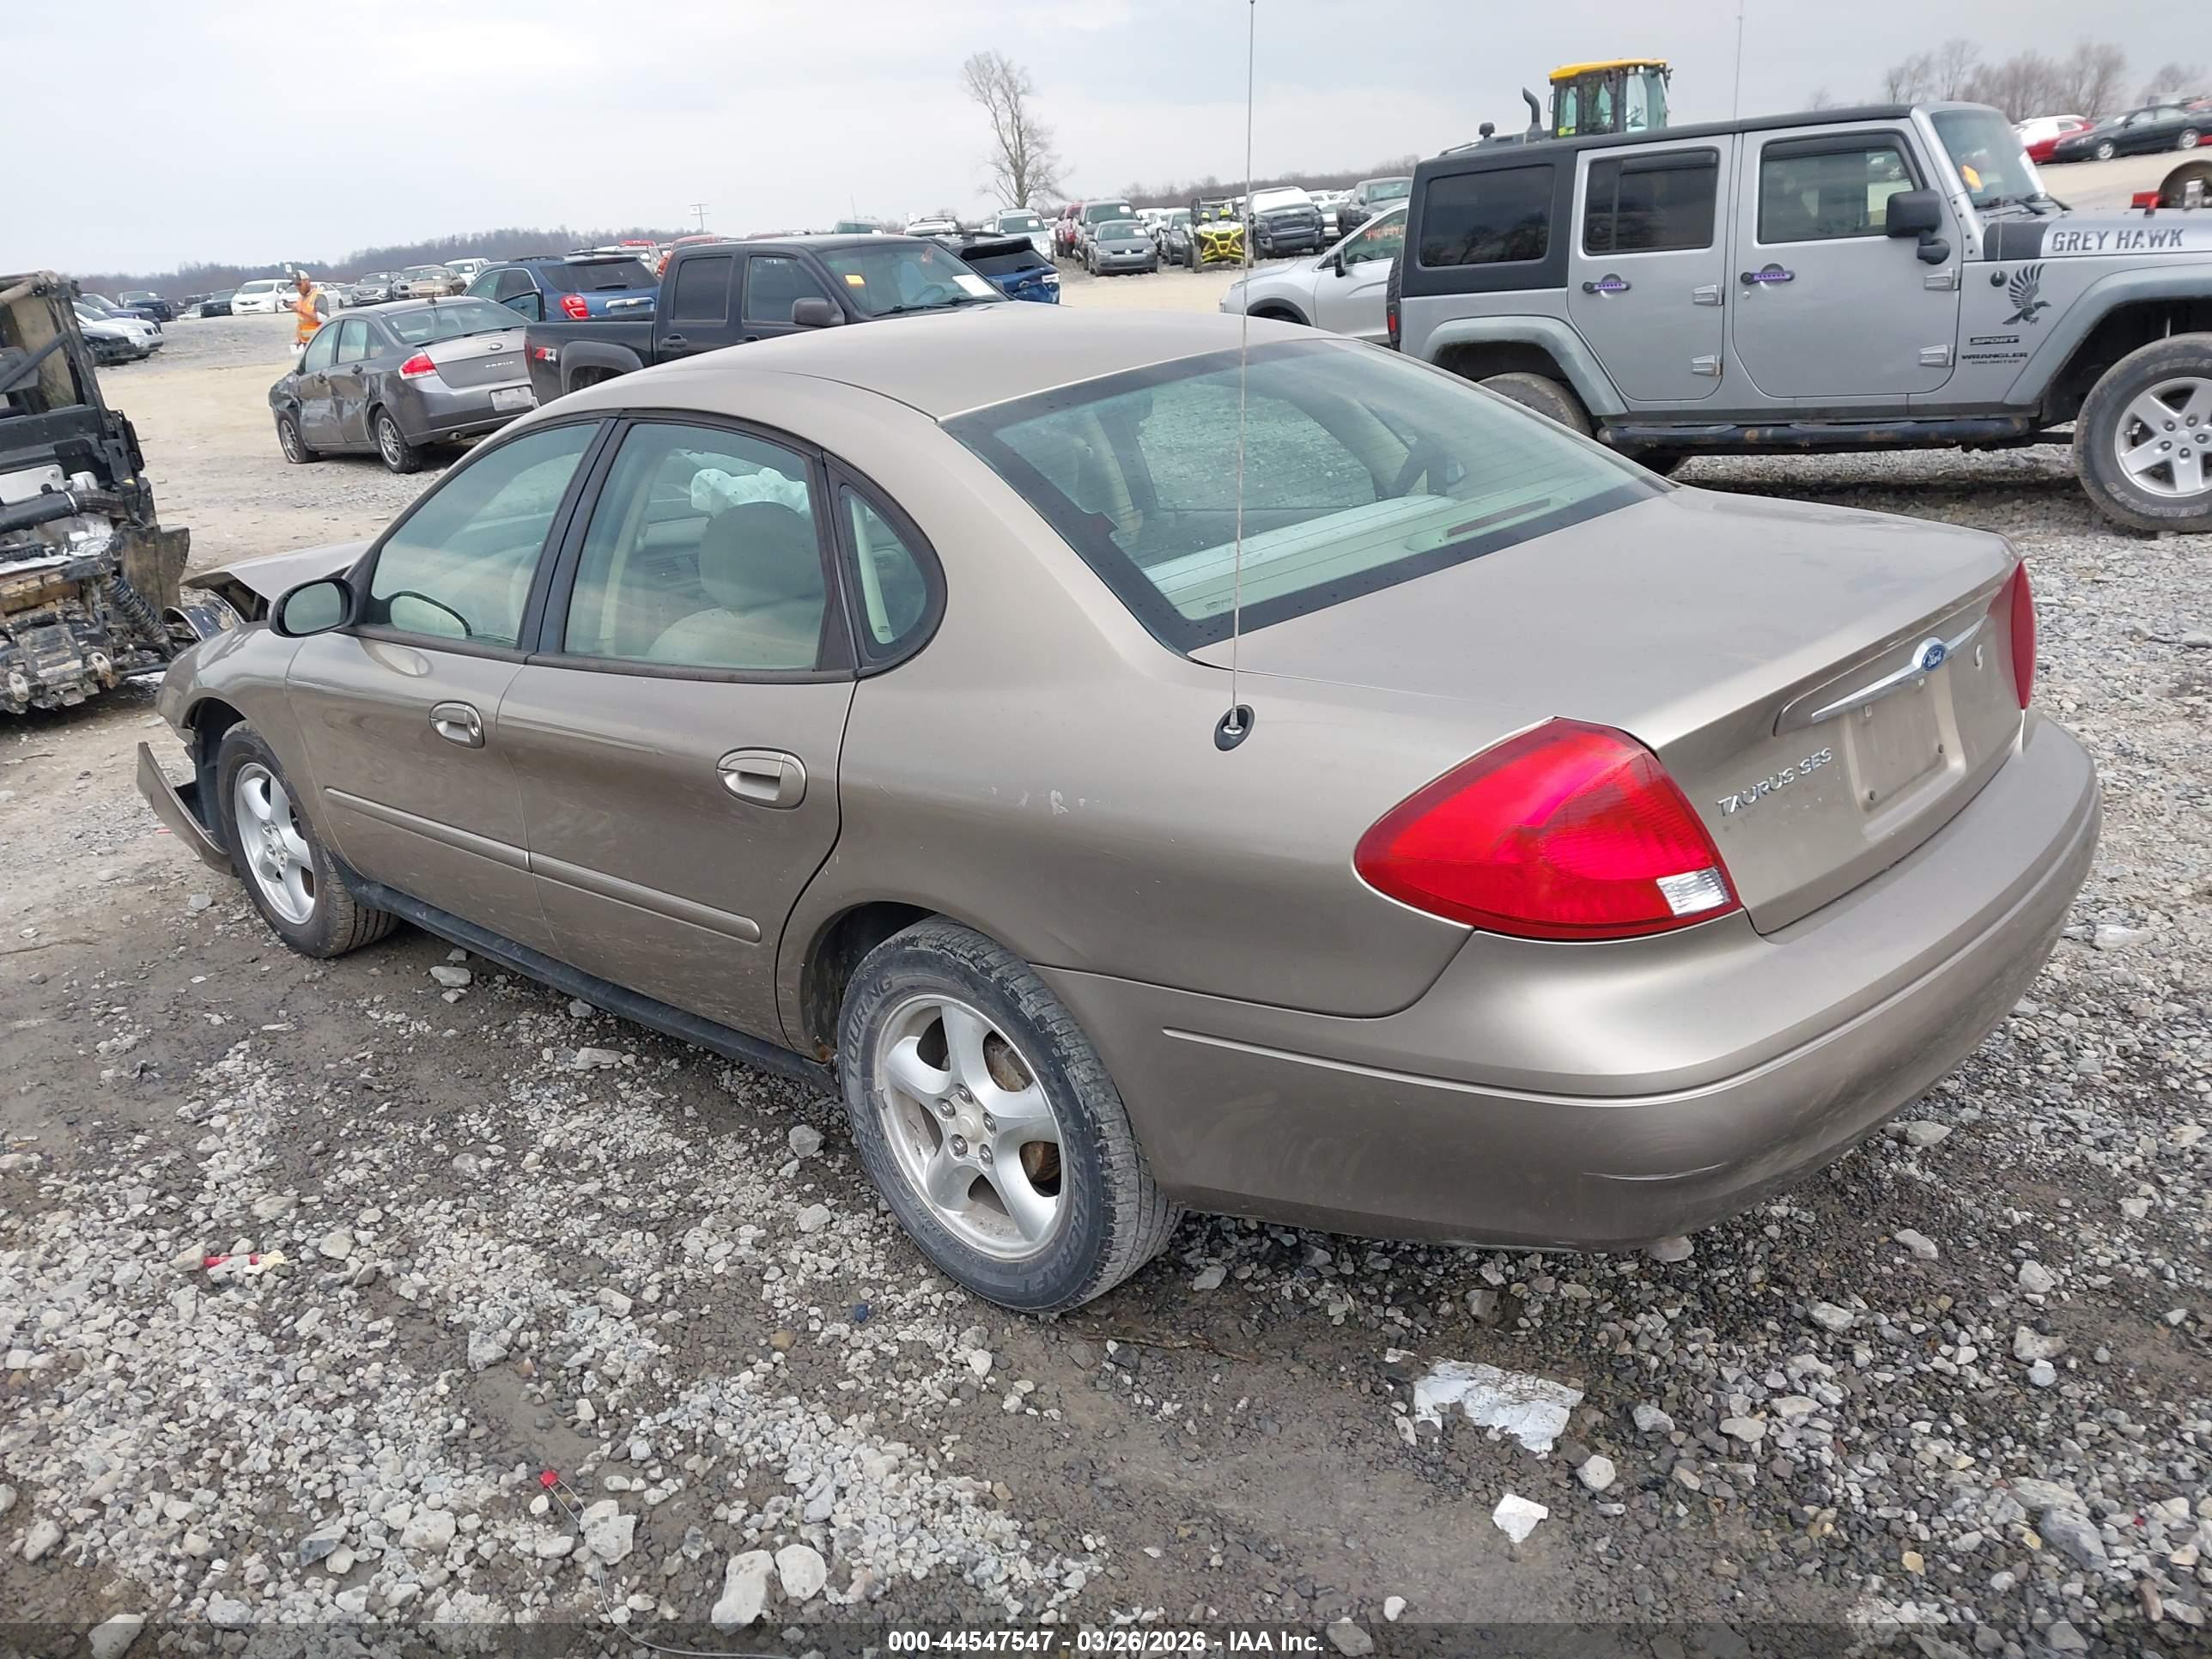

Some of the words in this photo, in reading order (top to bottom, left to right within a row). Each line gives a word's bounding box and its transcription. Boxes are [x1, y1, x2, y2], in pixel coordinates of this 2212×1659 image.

[2052, 231, 2109, 251] GREY
[2116, 228, 2185, 249] HAWK
[1971, 336, 2019, 344] SPORT
[1717, 767, 1795, 817] TAURUS
[1799, 747, 1832, 775] SES
[846, 975, 893, 1079] TOURING
